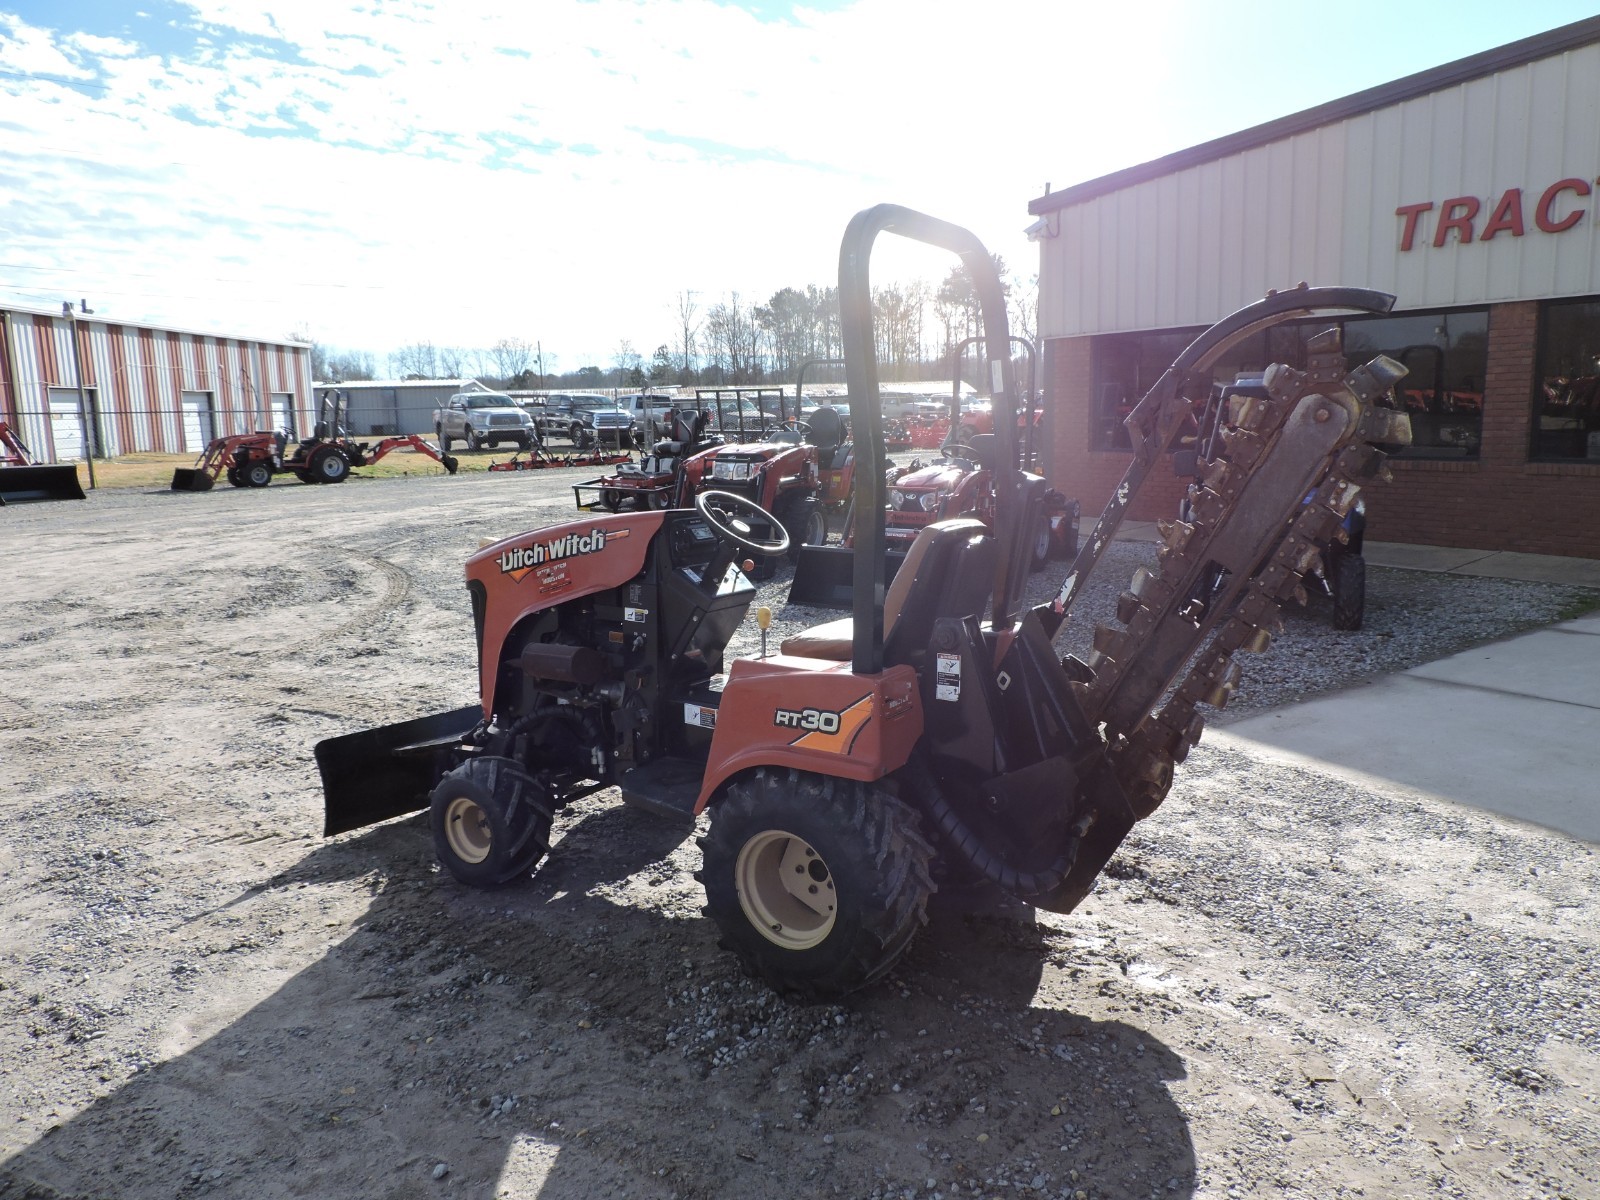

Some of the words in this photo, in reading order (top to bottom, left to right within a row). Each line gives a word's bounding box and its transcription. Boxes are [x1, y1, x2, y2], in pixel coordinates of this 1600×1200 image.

[1395, 176, 1600, 252] TRAC
[501, 543, 546, 572] Ditch
[548, 529, 605, 559] Witch
[775, 708, 840, 733] RT30
